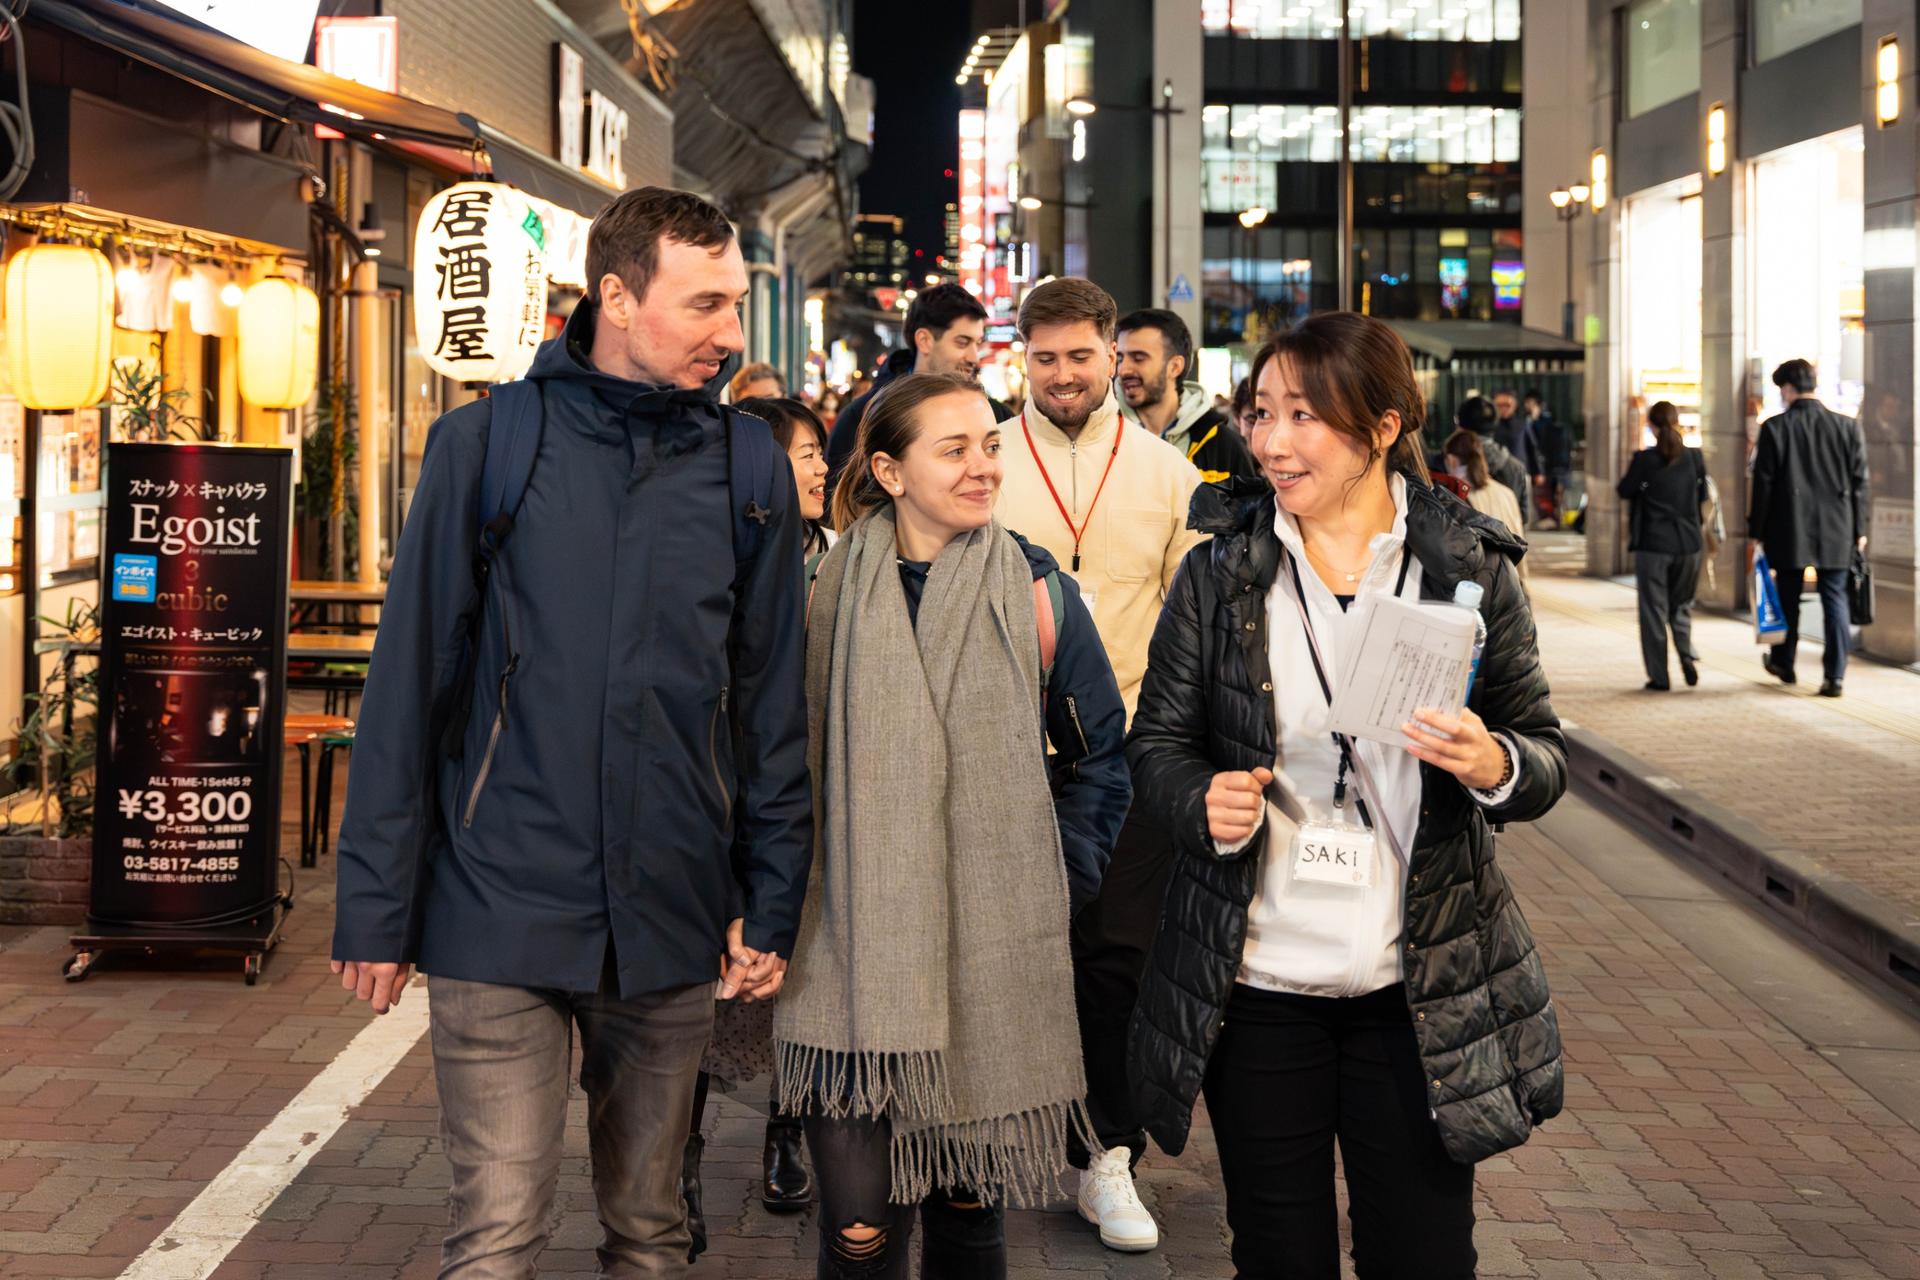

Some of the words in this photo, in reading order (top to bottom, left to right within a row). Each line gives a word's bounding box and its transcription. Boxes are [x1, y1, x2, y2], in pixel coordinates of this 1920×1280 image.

[431, 191, 495, 361] 居酒屋
[130, 503, 261, 556] Egoist
[184, 560, 199, 581] 3
[156, 585, 228, 611] cubic
[148, 776, 169, 786] ALL
[118, 788, 252, 825] ¥3,300
[124, 855, 239, 871] 03-5817-4855
[1302, 844, 1357, 867] SAKI
